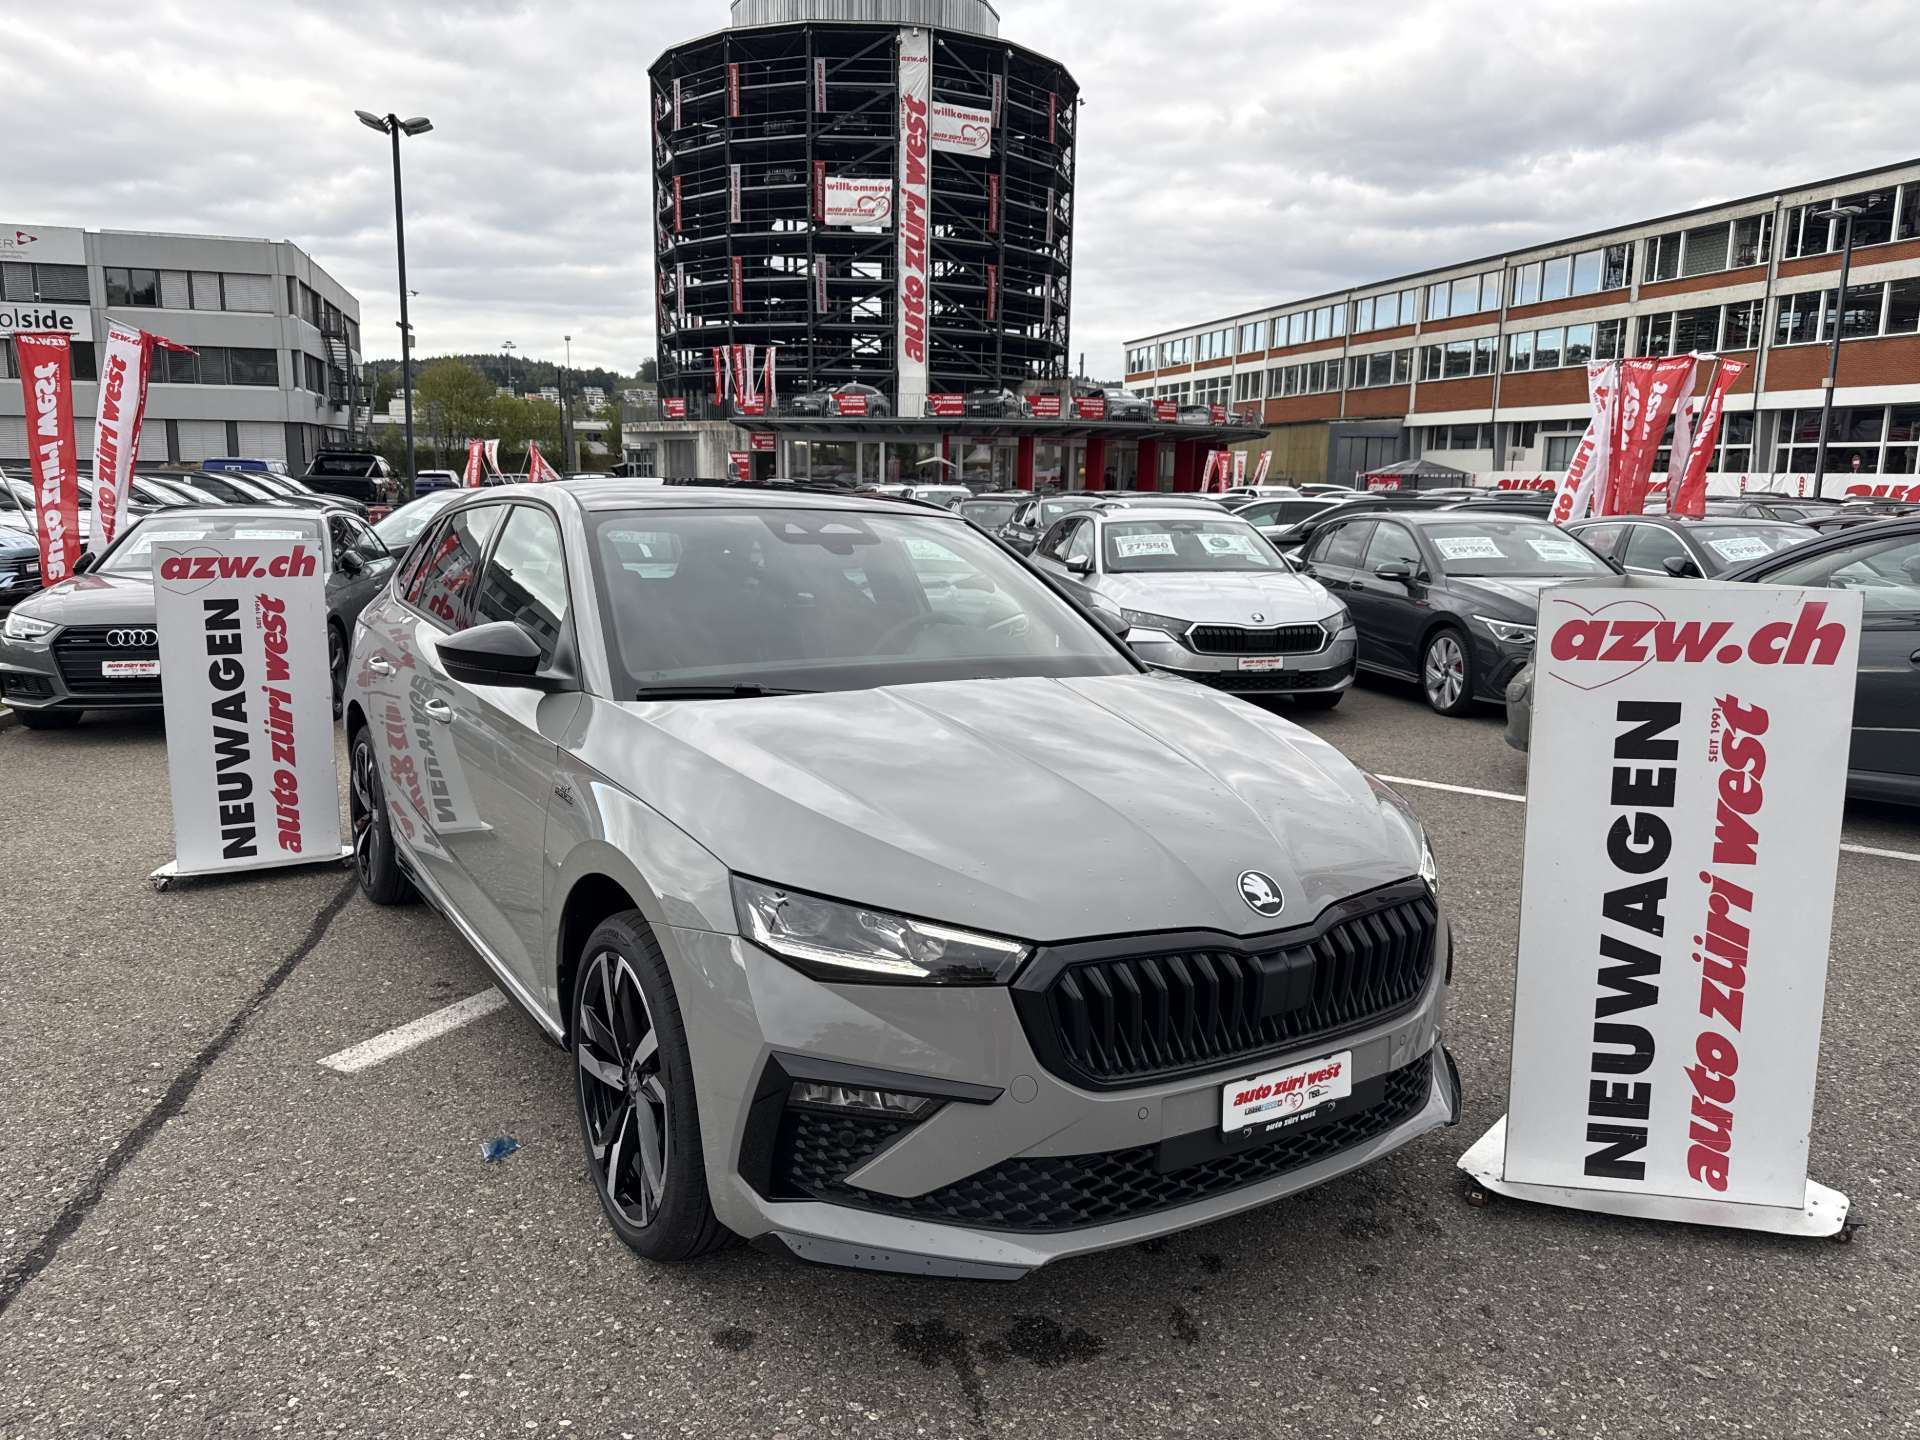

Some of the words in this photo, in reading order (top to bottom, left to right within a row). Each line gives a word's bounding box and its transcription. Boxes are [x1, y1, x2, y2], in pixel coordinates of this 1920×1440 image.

[902, 94, 926, 186] west
[934, 108, 990, 123] willkommen
[827, 182, 890, 192] willkommen
[900, 188, 926, 272] züri
[904, 275, 926, 364] auto
[102, 354, 127, 420] west
[96, 421, 118, 486] züri
[1496, 474, 1556, 490] auto
[160, 544, 316, 582] azw.ch
[255, 593, 290, 681] west
[1550, 602, 1847, 665] azw.ch
[204, 598, 258, 860] NEUWAGEN
[262, 686, 296, 768] züri
[1708, 737, 1718, 763] SEIT
[1710, 707, 1724, 735] 1991
[270, 769, 302, 854] auto
[1712, 694, 1770, 865] west
[1584, 700, 1682, 1180] NEUWAGEN
[1692, 871, 1754, 1032] züri
[1233, 1084, 1272, 1106] auto
[1272, 1072, 1306, 1096] züri
[1307, 1062, 1342, 1086] west
[1266, 1120, 1283, 1132] auto
[1300, 1110, 1316, 1120] west
[1684, 1030, 1741, 1192] auto
